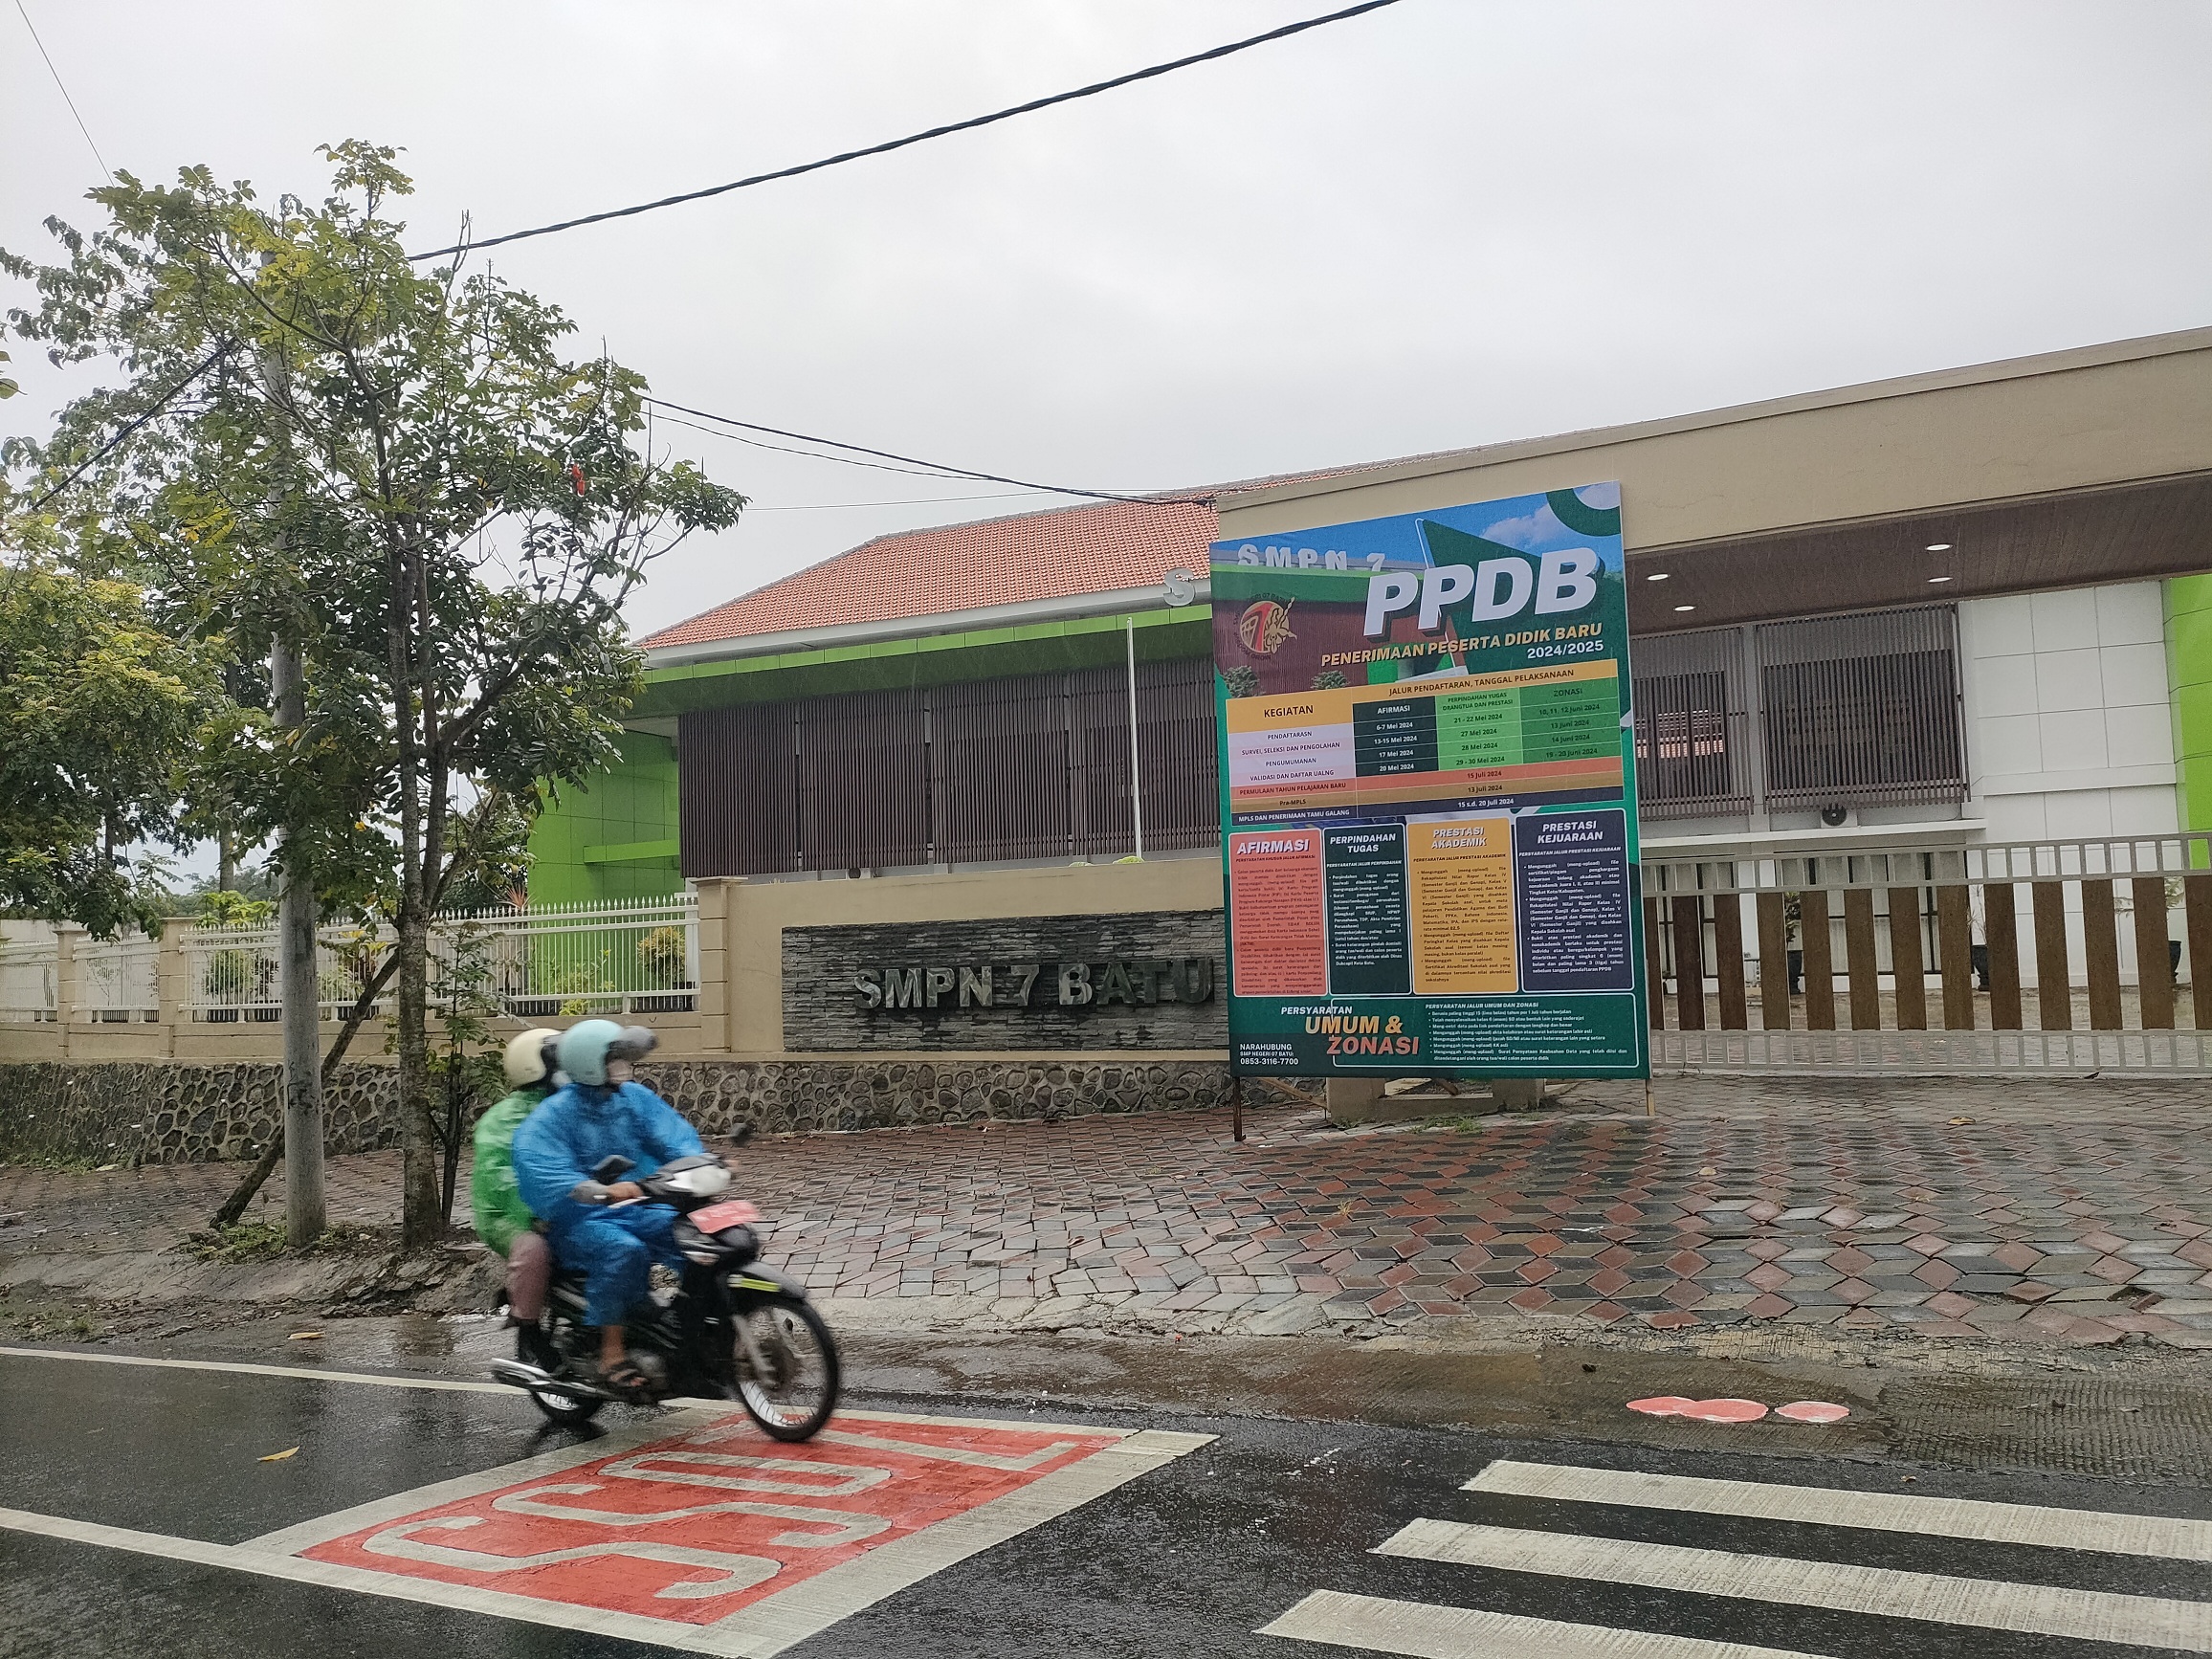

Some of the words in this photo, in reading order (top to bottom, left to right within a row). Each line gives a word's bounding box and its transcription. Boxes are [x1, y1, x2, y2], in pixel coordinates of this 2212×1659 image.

[1238, 544, 1347, 570] SMPN
[1367, 553, 1385, 571] 7
[1163, 568, 1196, 606] S
[1363, 547, 1601, 636] PPDB
[1321, 644, 1425, 667] PENERIMAAN
[1427, 635, 1500, 654] PESERTA
[1505, 629, 1552, 647] DIDIK
[1555, 623, 1603, 640] BARU
[1527, 640, 1604, 658] 2024/2025
[1389, 687, 1412, 696] JALUR
[1414, 681, 1473, 692] PENDAFTARAN,
[1475, 677, 1512, 686] TANGGAL
[1515, 670, 1573, 682] PELAKSANAAN
[1448, 694, 1487, 702] PERPINDAHAN
[1554, 688, 1582, 697] ZONASI
[1264, 705, 1313, 718] KEGIATAN
[1378, 705, 1410, 714] AFIRMASI
[1240, 787, 1274, 795] PERMULAAN
[1269, 812, 1306, 820] PENERIMAAN
[1433, 827, 1484, 838] PRESTASI
[1543, 821, 1596, 832] PRESTASI
[1330, 833, 1396, 844] PERPINDAHAN
[1431, 837, 1487, 849] AKADEMIK
[1537, 832, 1603, 843] KEJUARAAN
[1237, 839, 1310, 854] AFIRMASI
[1348, 845, 1379, 853] TUGAS
[853, 965, 993, 1009] SMPN
[1011, 964, 1040, 1006] 7
[1058, 959, 1213, 1006] BATU
[1282, 1006, 1352, 1014] PERSYARATAN
[1305, 1016, 1380, 1033] UMUM
[1385, 1016, 1403, 1033] &
[1326, 1036, 1419, 1054] ZONASI
